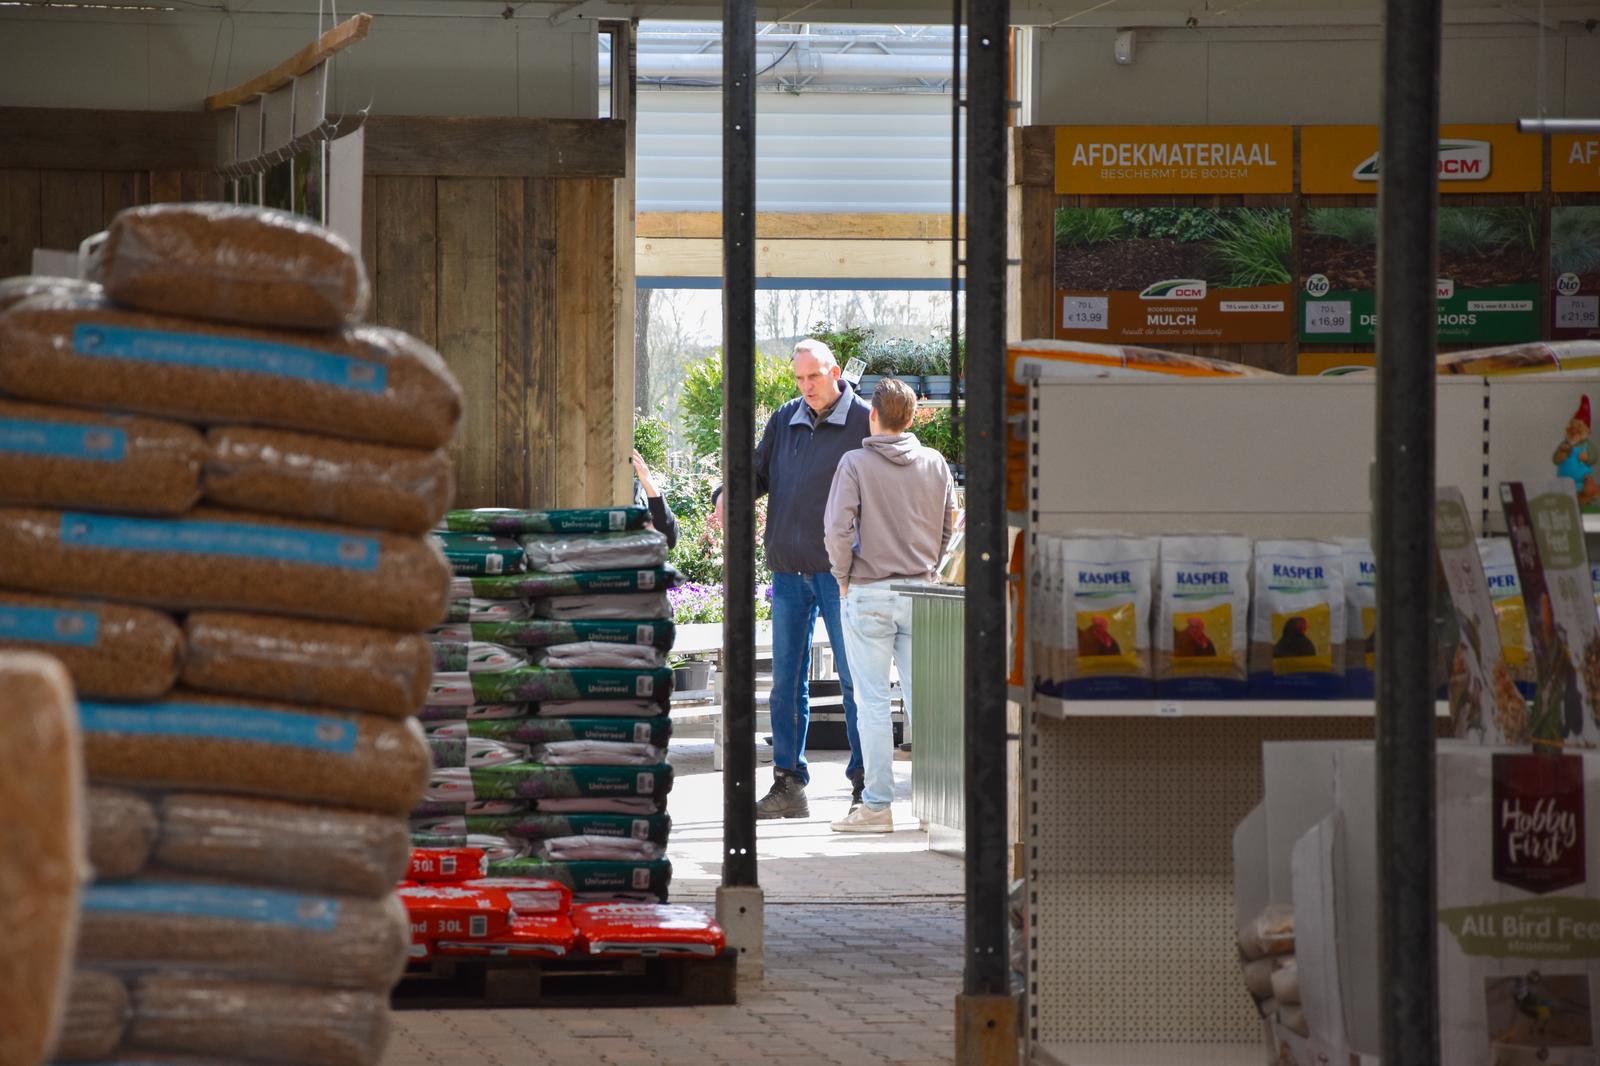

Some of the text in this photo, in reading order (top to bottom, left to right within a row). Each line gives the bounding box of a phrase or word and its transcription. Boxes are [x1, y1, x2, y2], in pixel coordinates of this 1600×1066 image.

[1072, 143, 1276, 167] AFDEKMATERIAAL
[1101, 168, 1248, 179] BESCHERMT DE BODEM
[1438, 160, 1480, 175] CM
[1308, 279, 1328, 292] bio
[1558, 277, 1578, 291] bio
[1175, 289, 1202, 297] DCM
[1075, 313, 1102, 323] 13,99
[1147, 314, 1197, 326] MULCH
[1319, 316, 1345, 328] 16,99
[1568, 312, 1595, 323] 21,95
[561, 520, 602, 529] Universeel
[1078, 571, 1131, 584] KASPER
[1177, 571, 1229, 585] KASPER
[1273, 564, 1324, 580] KASPER
[588, 580, 630, 588] Universeel
[1487, 574, 1516, 588] PER
[588, 684, 629, 693] Universeel
[585, 730, 626, 739] Universeel
[588, 782, 629, 791] Universeel
[1502, 797, 1577, 848] Hobby
[1508, 831, 1562, 865] First
[413, 860, 434, 873] 30L
[584, 877, 625, 886] Universeel
[438, 919, 463, 933] 30L
[1461, 914, 1497, 937] All
[1502, 914, 1551, 938] Bird
